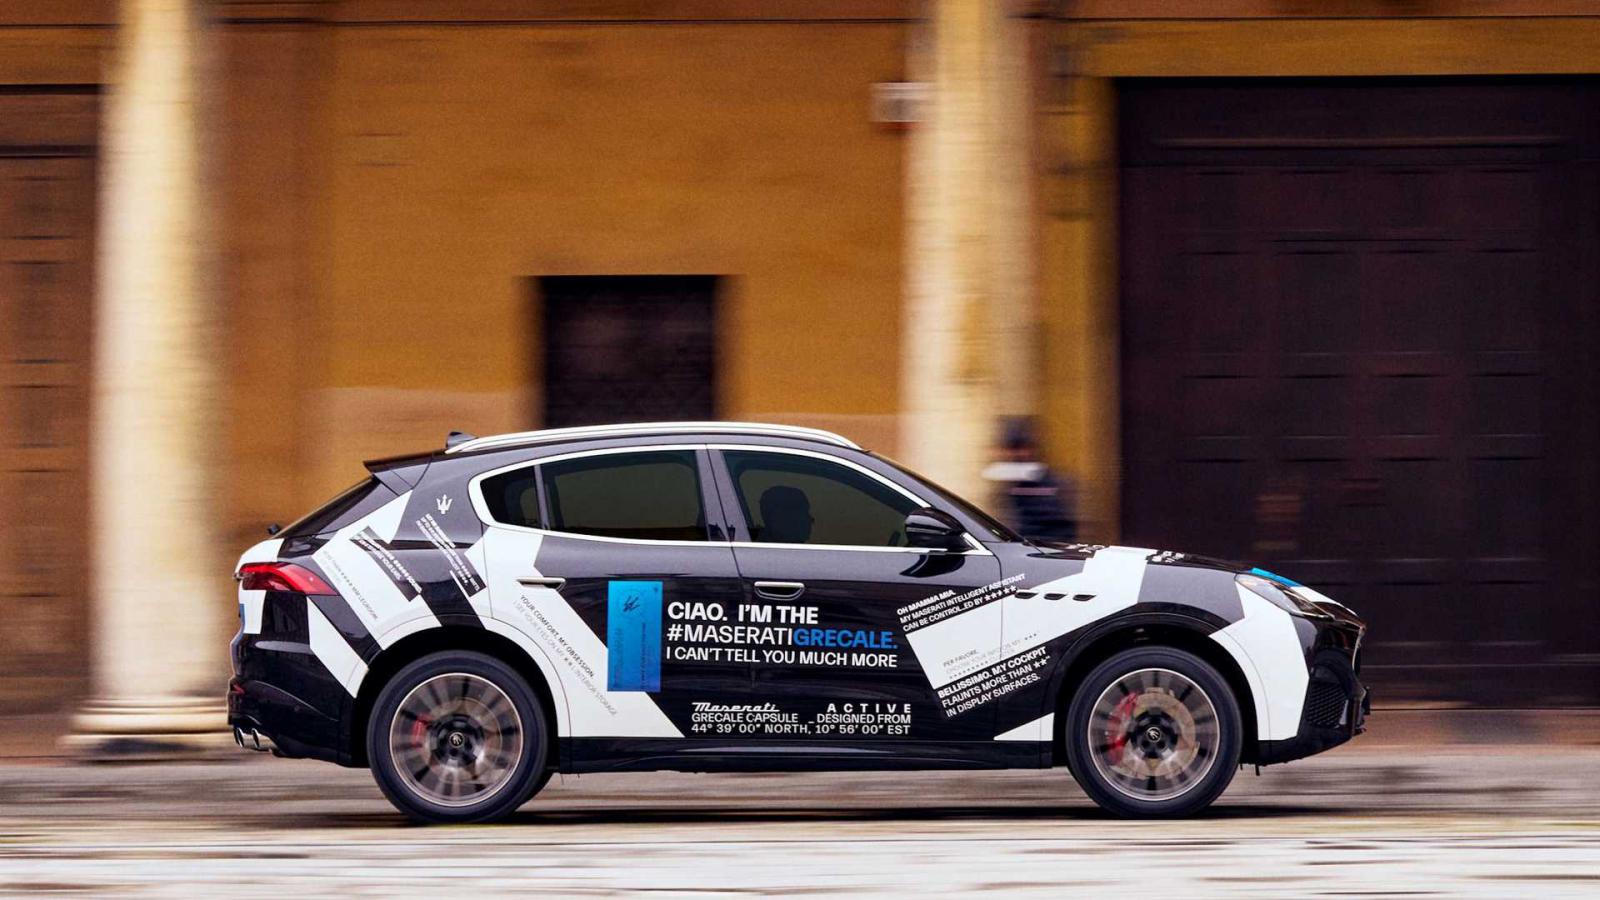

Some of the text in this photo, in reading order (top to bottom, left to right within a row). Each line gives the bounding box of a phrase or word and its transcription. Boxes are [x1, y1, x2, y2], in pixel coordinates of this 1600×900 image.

[668, 601, 818, 624] CIAO. I'M THE
[897, 589, 955, 615] OH MAMMA MIA.
[900, 615, 911, 623] MY
[912, 603, 945, 619] MASERATI
[946, 586, 988, 606] INTELLIGENT
[902, 621, 918, 632] CAN
[919, 617, 929, 625] BE
[974, 597, 983, 605] BY
[520, 594, 596, 679] YOUR COMFORT, MY OBSESSION.
[667, 624, 898, 649] #MASERATIGRECALE.
[667, 648, 897, 667] I CAN'T TELL YOU MUCH MORE
[937, 671, 991, 698] BELLISSIMO.
[991, 663, 1007, 675] MY
[1007, 646, 1046, 668] COCKPIT
[941, 664, 1032, 707] FLAUNTS MORE THAN
[945, 672, 1040, 717] IN DISPLAY SURFACES.
[692, 702, 779, 712] Maserati
[692, 713, 744, 723] GRECALE
[747, 713, 798, 723] CAPSULE
[817, 714, 875, 723] DESIGNED
[877, 714, 911, 724] FROM
[765, 724, 811, 734] NORTH,
[888, 725, 910, 734] EST
